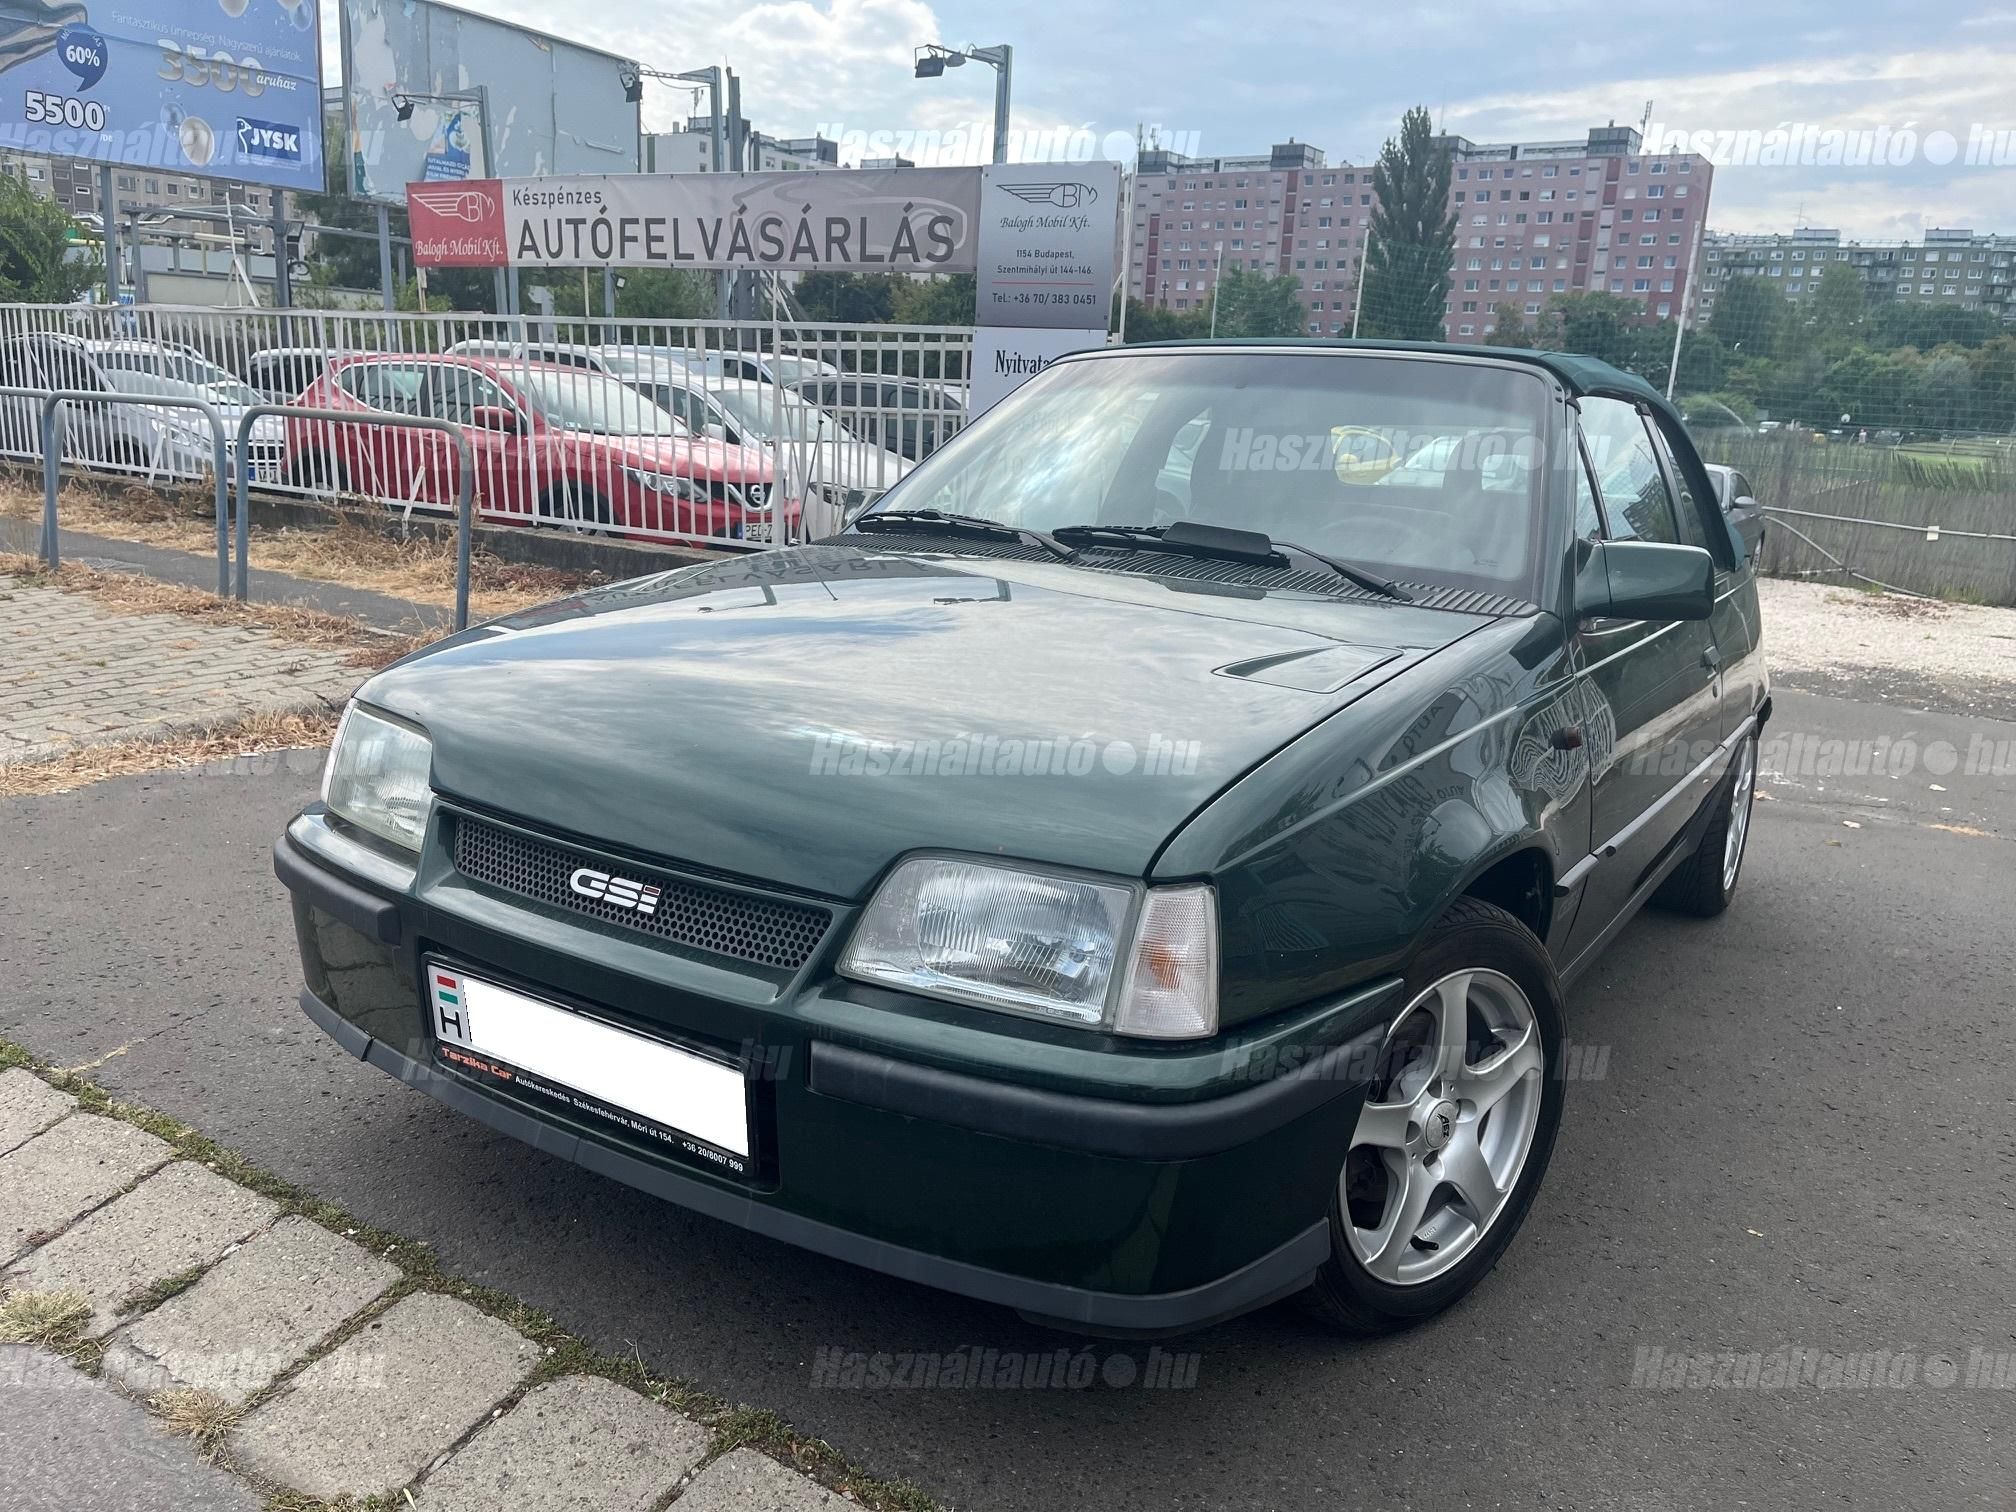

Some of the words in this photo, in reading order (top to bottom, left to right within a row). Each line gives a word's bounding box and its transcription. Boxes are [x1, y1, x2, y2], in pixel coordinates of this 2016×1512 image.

[66, 45, 100, 67] 60%
[157, 38, 265, 97] 3500
[25, 90, 106, 131] 5500
[251, 128, 298, 153] JYSK
[513, 188, 602, 210] Készpénzes
[517, 202, 955, 263] AUTÓFELVÁSÁRLÁS
[1000, 215, 1034, 233] Balogh
[1035, 214, 1067, 229] Mobil
[1069, 215, 1091, 233] Kft.
[415, 236, 449, 262] Balogh
[450, 235, 482, 256] Mobil
[482, 236, 504, 262] Kft.
[1016, 249, 1032, 258] 1154
[1034, 249, 1075, 260] Budapest,
[997, 264, 1048, 276] Szentmihályi
[1050, 264, 1058, 274] út
[992, 292, 1011, 303] Tel.:
[1013, 293, 1030, 304] +36
[1033, 292, 1050, 305] 70/
[1052, 294, 1070, 304] 383
[1073, 294, 1097, 305] 0451
[439, 1005, 463, 1038] H
[442, 1047, 489, 1072] Tarzika
[491, 1065, 513, 1080] Car
[515, 1075, 571, 1103] Autókereskedés
[573, 1097, 630, 1128] Székesfehérvár,
[631, 1119, 648, 1134] Móri
[649, 1127, 658, 1138] út
[659, 1131, 675, 1144] 154.
[682, 1140, 696, 1152] +36
[698, 1146, 728, 1166] 20/8007
[729, 1159, 744, 1173] 999
